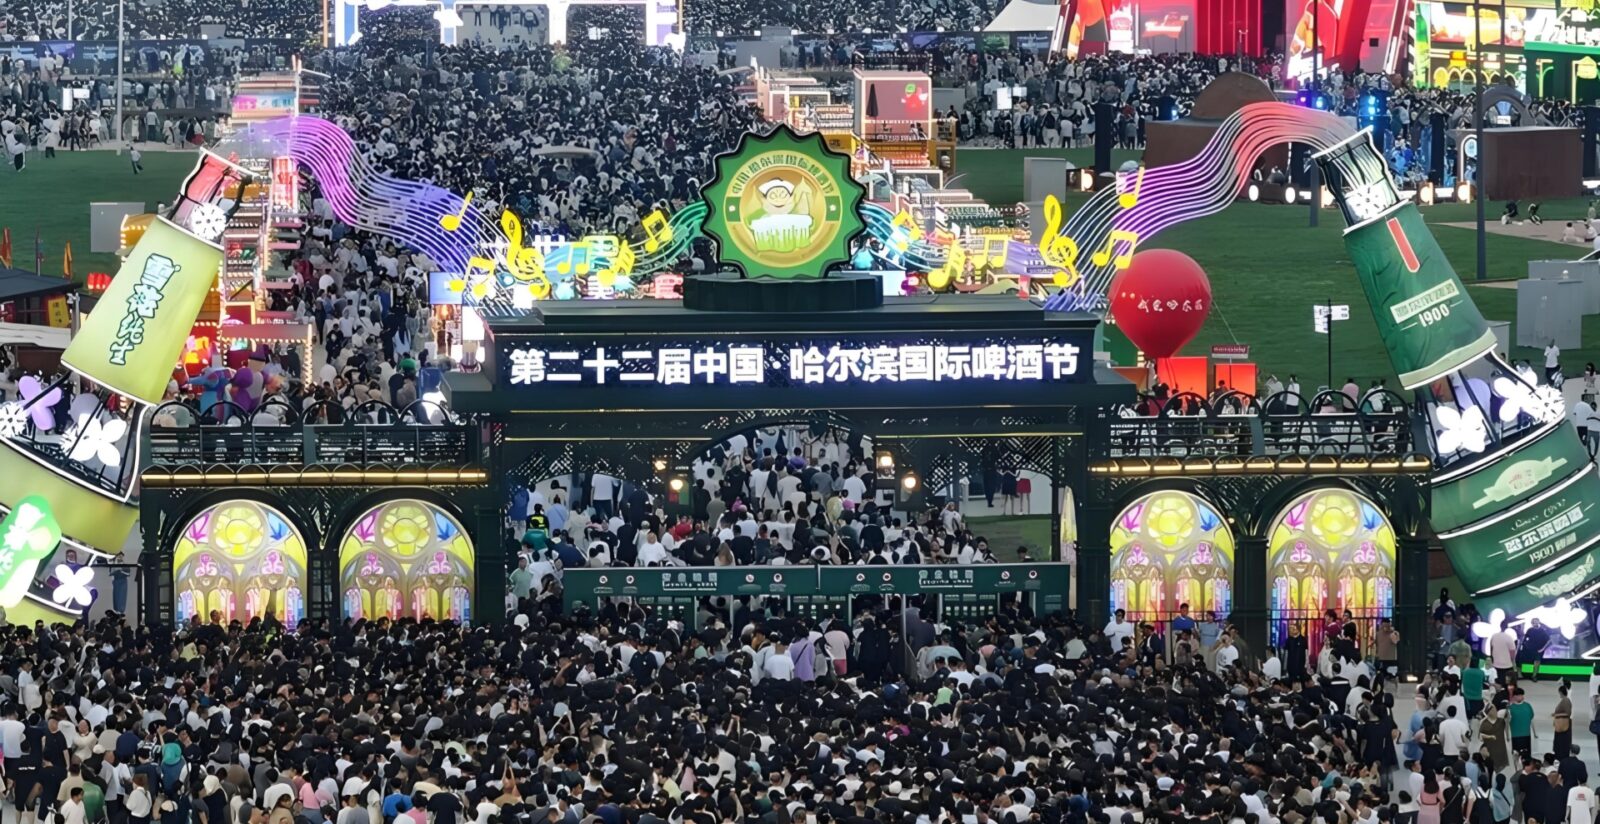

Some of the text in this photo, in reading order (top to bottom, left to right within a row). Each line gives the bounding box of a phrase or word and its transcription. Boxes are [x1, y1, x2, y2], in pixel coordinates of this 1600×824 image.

[1419, 303, 1450, 327] 1900
[509, 342, 1080, 385] 第二十二届中国·哈尔滨国际啤酒节
